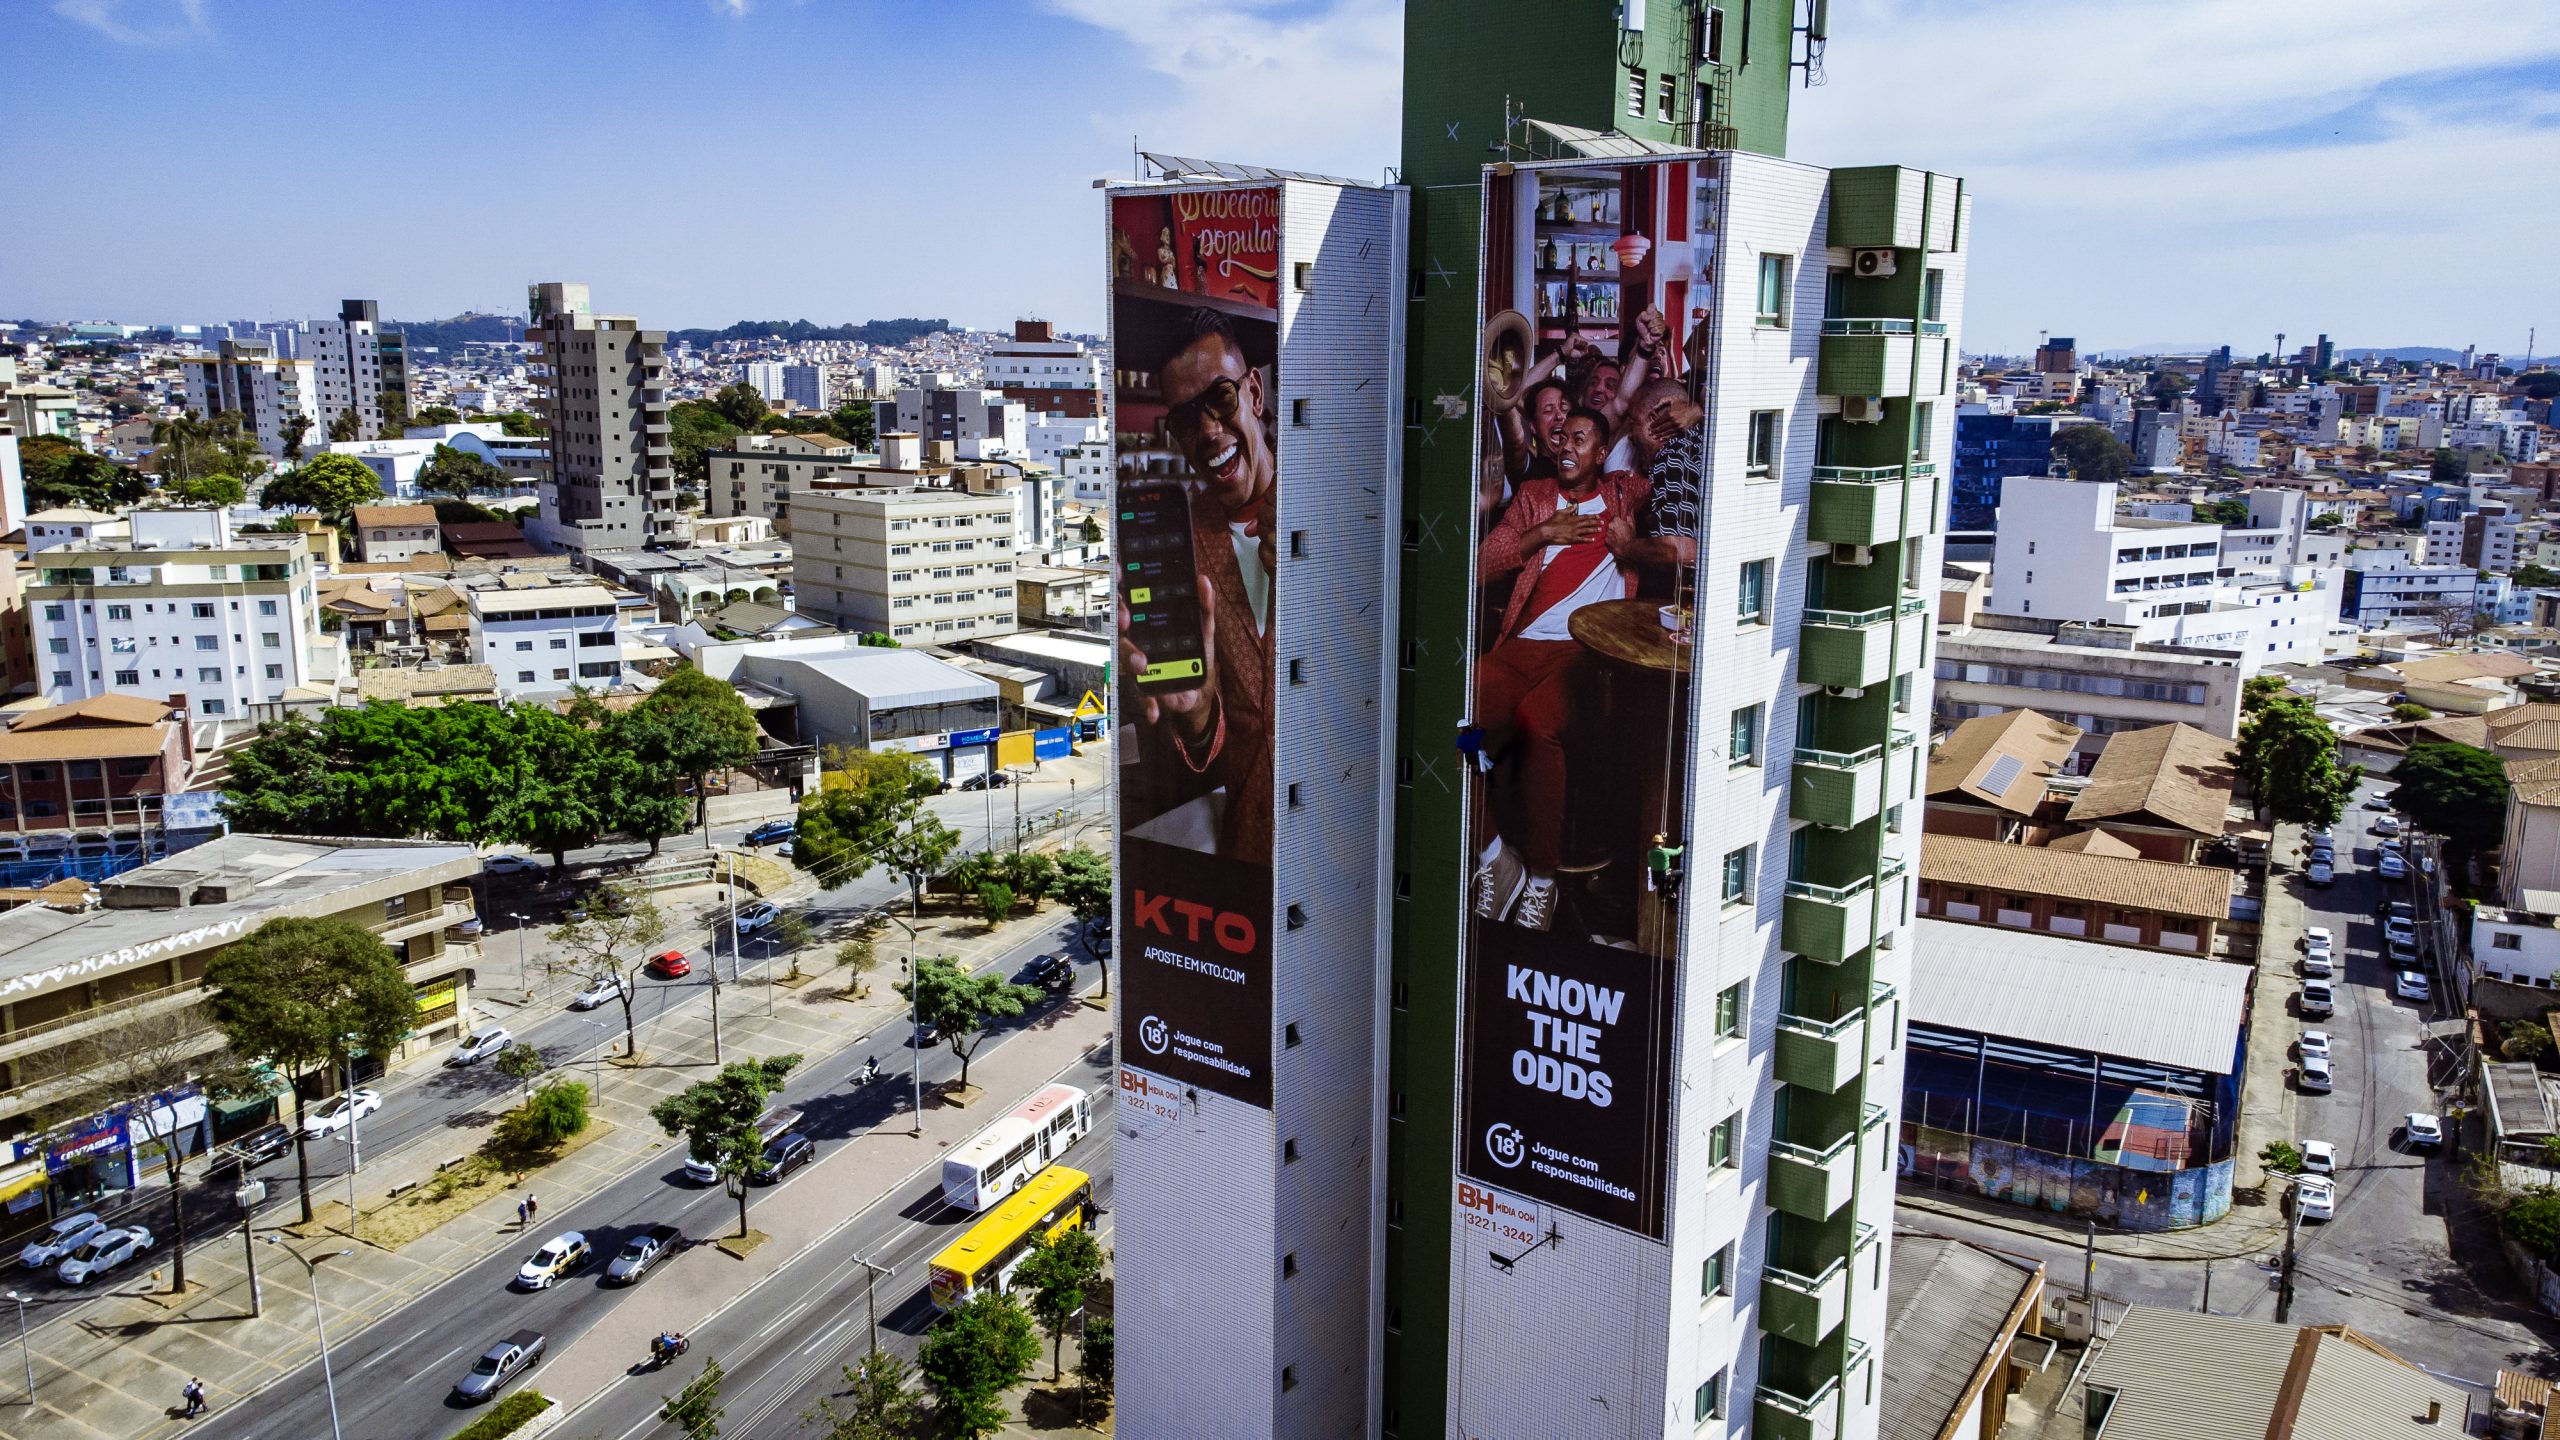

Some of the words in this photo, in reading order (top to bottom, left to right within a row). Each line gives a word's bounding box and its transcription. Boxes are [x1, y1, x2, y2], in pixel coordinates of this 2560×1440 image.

[1135, 889, 1256, 954] KTO
[1144, 945, 1184, 968] APOSTE
[1184, 956, 1200, 973] EM
[1200, 960, 1245, 985] KTO.COM
[427, 980, 453, 997] ALUGA
[1507, 963, 1626, 1026] KNOW
[1173, 1030, 1202, 1047] Jogue
[1203, 1041, 1224, 1054] com
[1527, 1010, 1602, 1064] THE
[1173, 1046, 1251, 1078] responsabilidade
[1512, 1049, 1613, 1108] ODDS
[1120, 1069, 1148, 1097] BH
[1165, 1091, 1179, 1102] OOH
[1128, 1095, 1178, 1122] 3221-3242
[1531, 1141, 1570, 1161] Jogue
[1571, 1155, 1599, 1172] com
[1531, 1159, 1636, 1202] responsabilidade
[1458, 1182, 1495, 1215] BH
[1495, 1202, 1516, 1217] MÍDIA
[1517, 1210, 1536, 1224] OOH
[1467, 1212, 1534, 1246] 3221-3242
